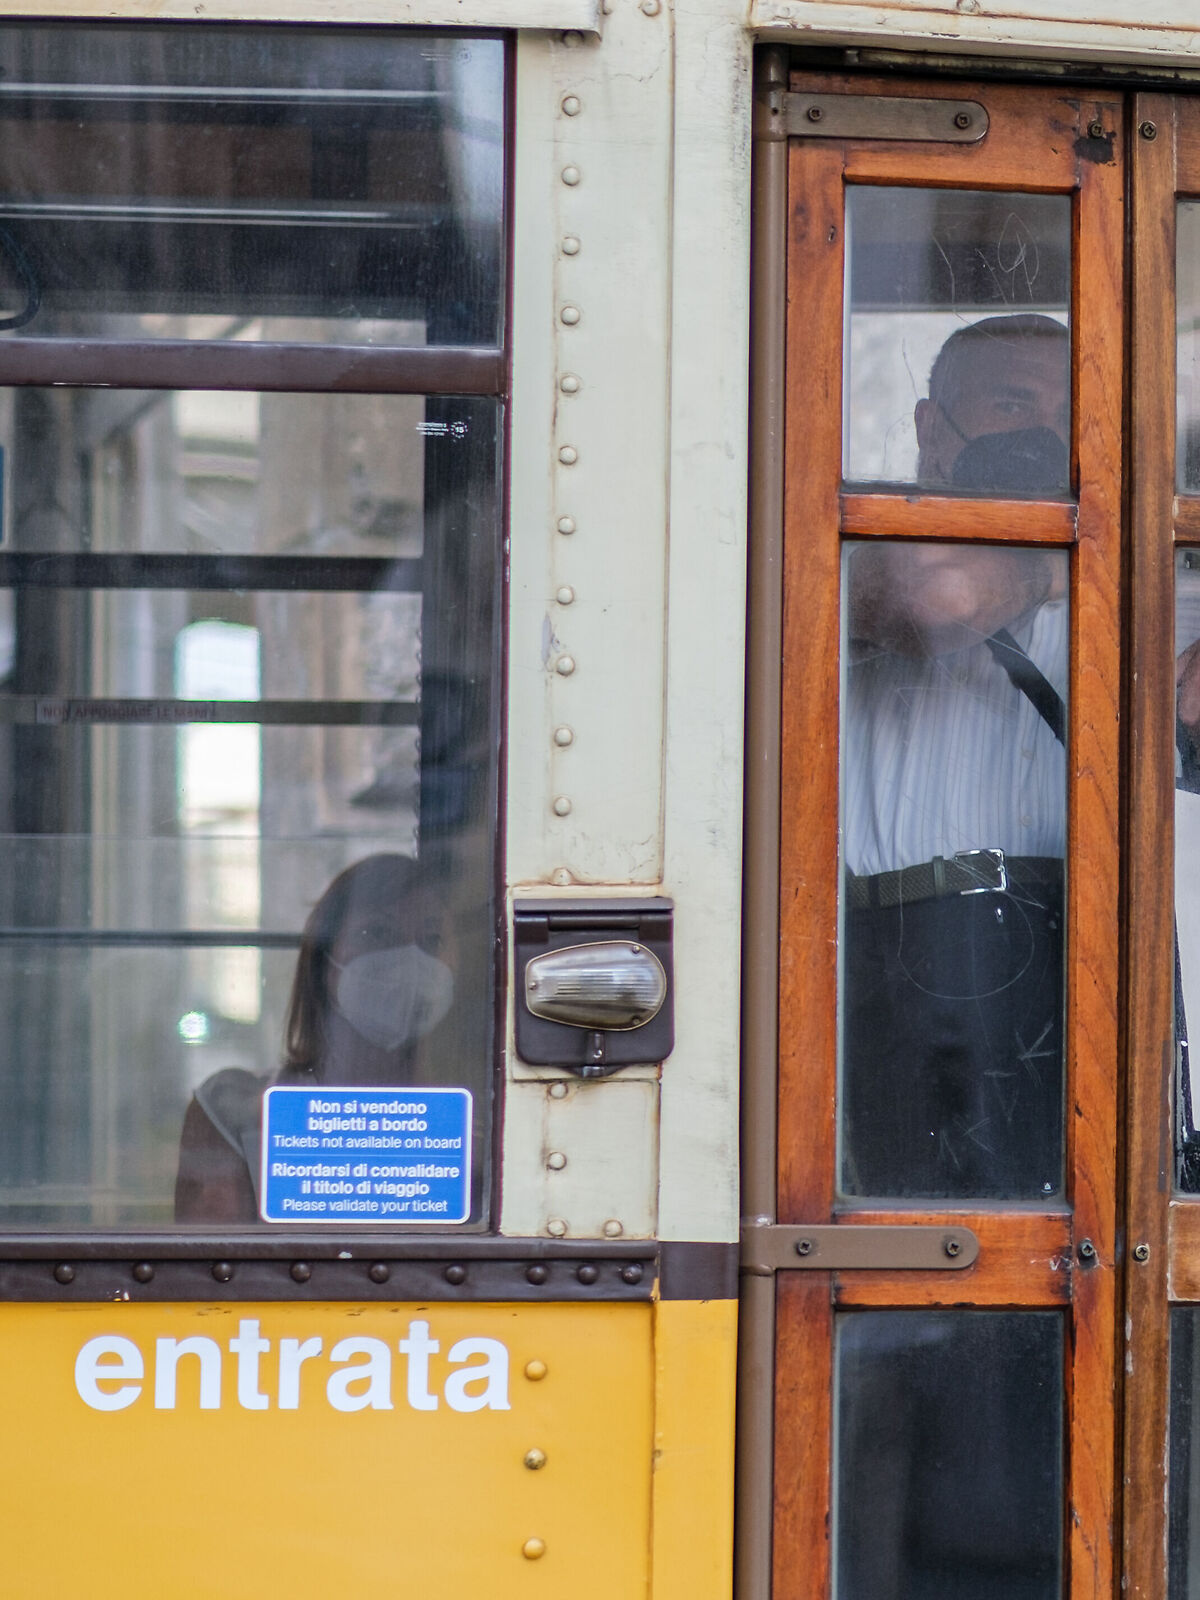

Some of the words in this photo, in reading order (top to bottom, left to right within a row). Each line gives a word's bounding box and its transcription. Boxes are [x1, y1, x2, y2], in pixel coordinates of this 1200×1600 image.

[309, 1100, 341, 1114] Non
[344, 1100, 357, 1114] si
[360, 1100, 428, 1115] vendono
[308, 1117, 366, 1133] biglietti
[369, 1120, 379, 1131] a
[382, 1117, 428, 1132] bordo
[273, 1135, 320, 1148] Tickets
[322, 1136, 344, 1149] not
[346, 1135, 401, 1149] available
[404, 1138, 421, 1149] on
[424, 1136, 462, 1150] board
[272, 1163, 350, 1178] Ricordarsi
[353, 1163, 368, 1178] di
[370, 1163, 460, 1179] convalidare
[301, 1180, 311, 1194] il
[314, 1180, 354, 1195] titolo
[356, 1181, 371, 1195] di
[374, 1181, 430, 1198] viaggio
[283, 1199, 326, 1212] Please
[329, 1199, 378, 1212] validate
[381, 1202, 410, 1215] your
[412, 1200, 448, 1213] ticket
[74, 1319, 512, 1413] entrata
